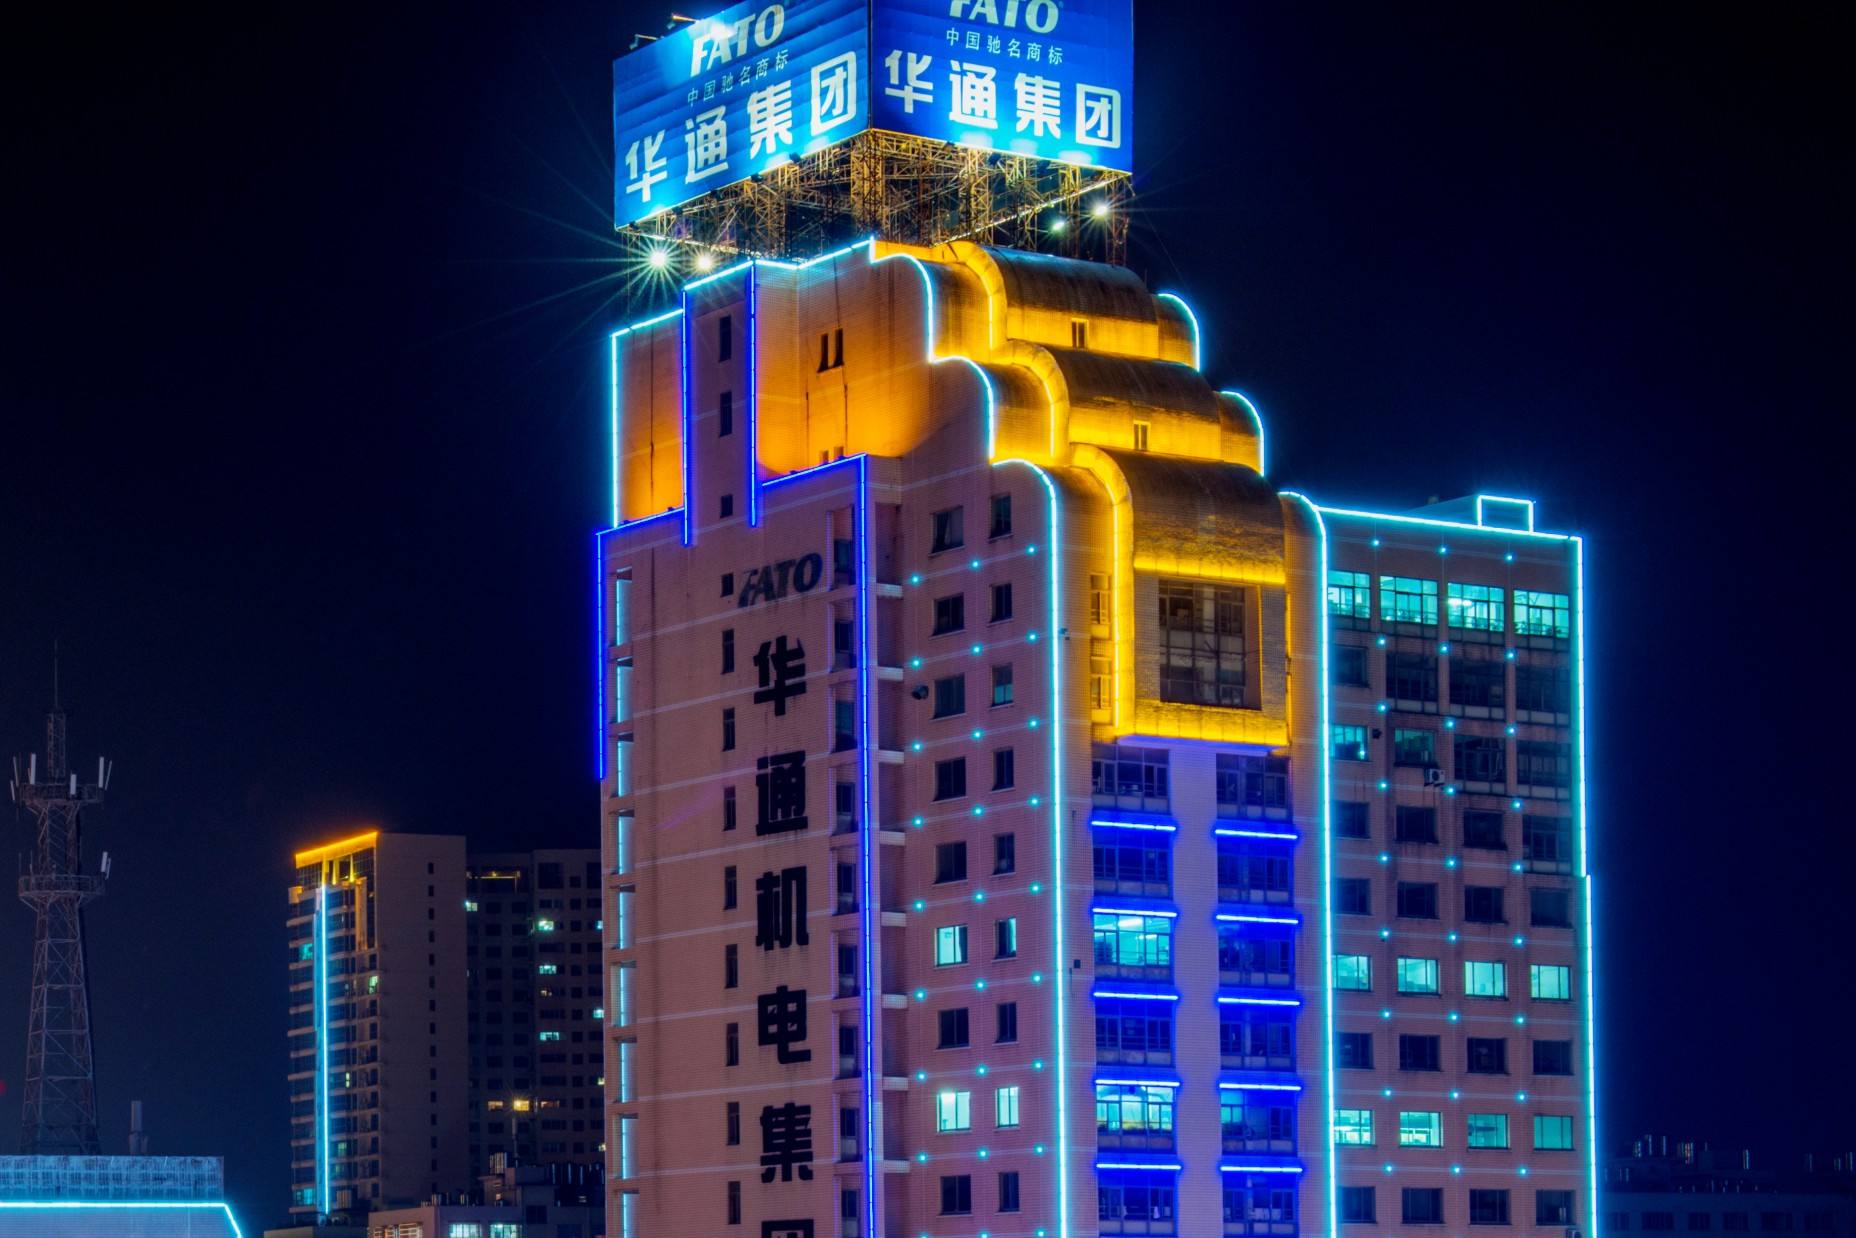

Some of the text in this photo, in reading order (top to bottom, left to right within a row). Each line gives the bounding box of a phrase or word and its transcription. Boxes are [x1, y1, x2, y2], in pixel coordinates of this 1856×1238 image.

[690, 4, 785, 77] FATO
[945, 27, 1063, 65] 中国驰名商标
[687, 49, 789, 107] 中国驰名商标
[885, 49, 1121, 149] 华通集团
[625, 51, 857, 203] 华通集团
[737, 552, 823, 608] FATO
